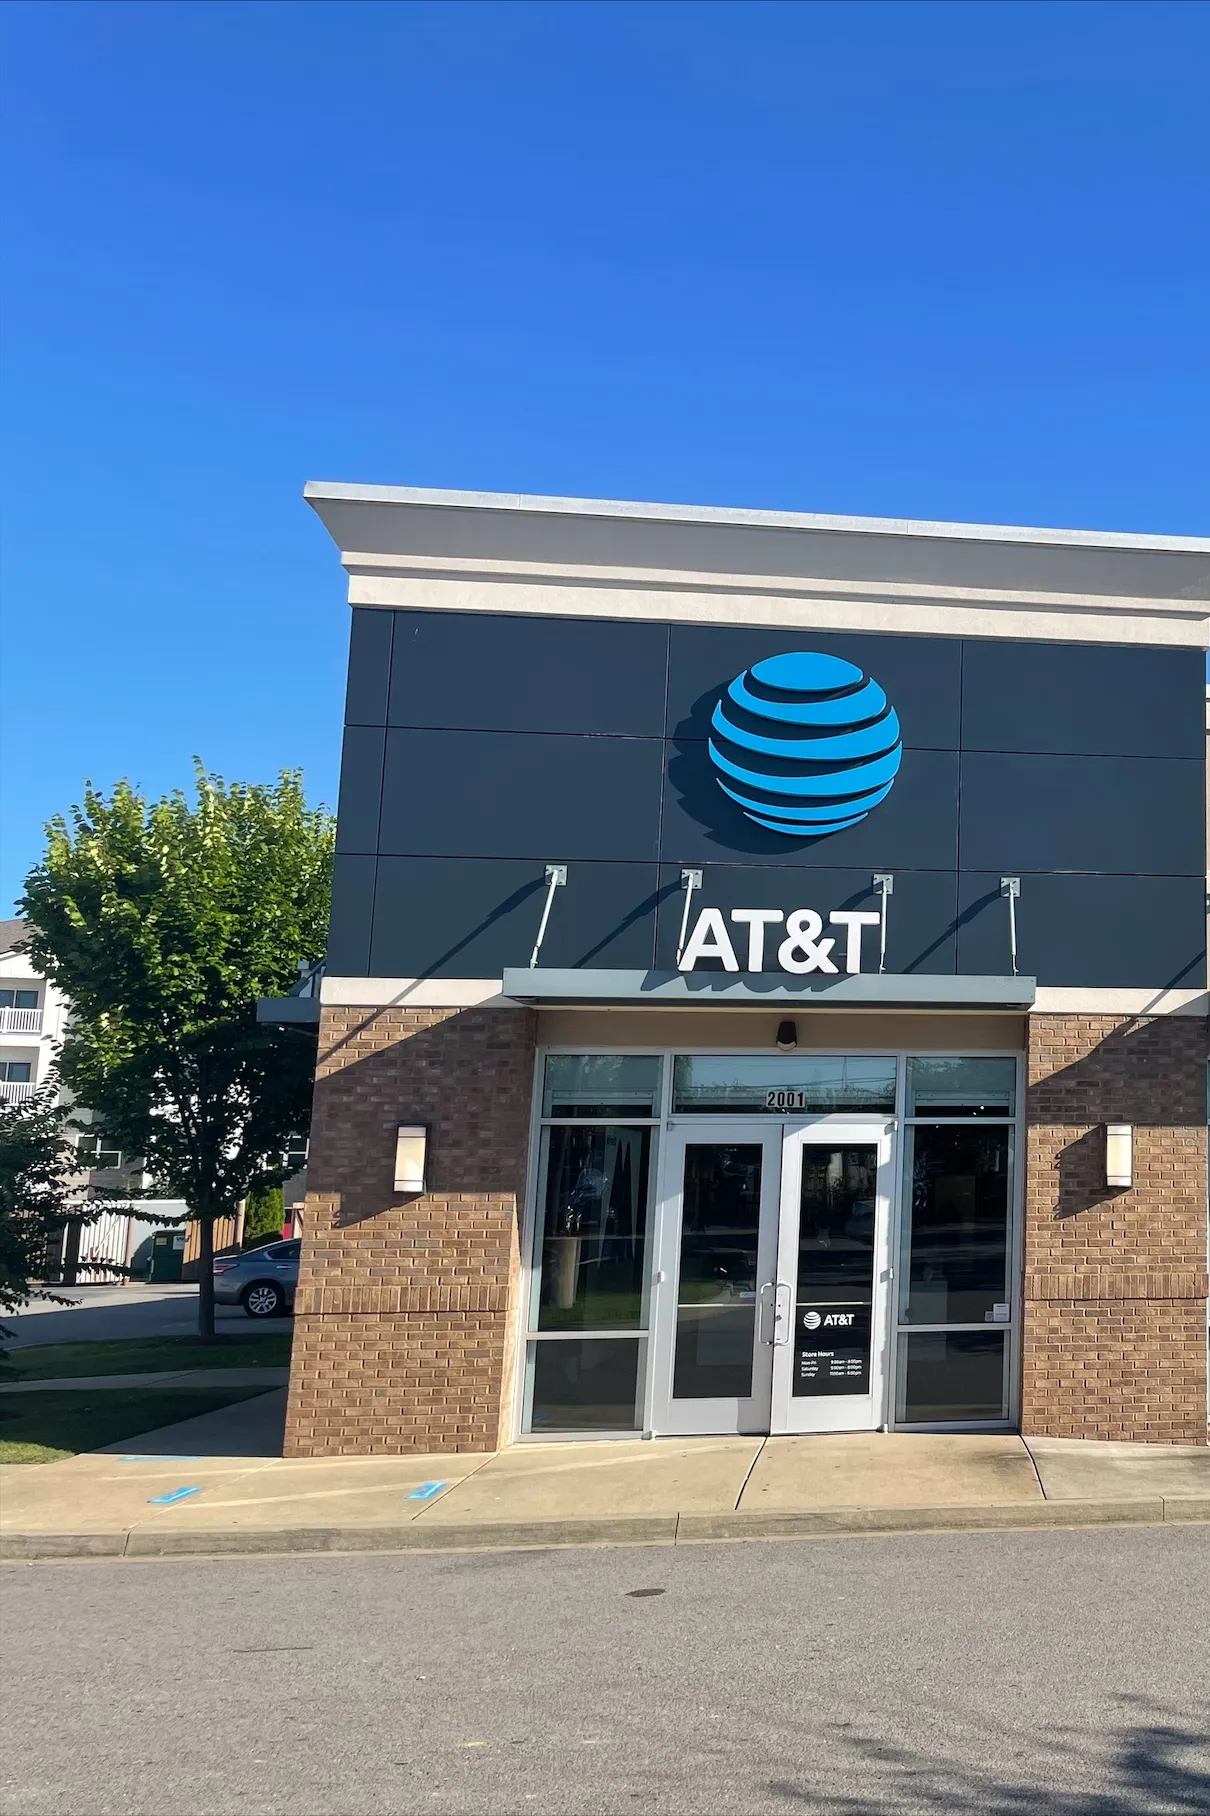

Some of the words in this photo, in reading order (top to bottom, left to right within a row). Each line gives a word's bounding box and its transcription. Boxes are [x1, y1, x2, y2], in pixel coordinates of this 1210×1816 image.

[678, 907, 880, 974] AT&T
[768, 1091, 804, 1107] 2001
[823, 1314, 855, 1326] AT&T
